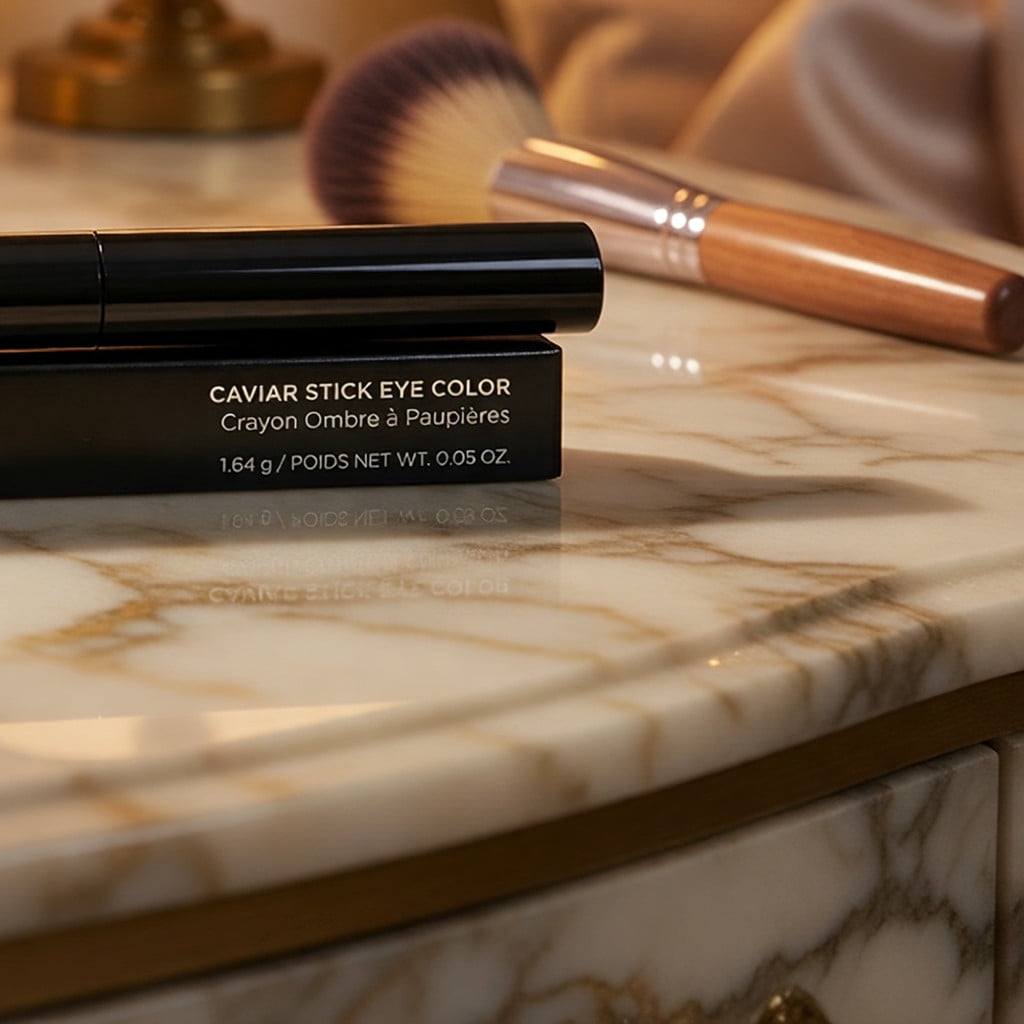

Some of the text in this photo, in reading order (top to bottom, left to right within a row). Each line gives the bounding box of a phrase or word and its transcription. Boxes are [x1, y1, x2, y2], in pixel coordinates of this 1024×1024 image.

[209, 377, 512, 404] CAVIAR STICK EYE COLOR
[220, 406, 511, 435] Crayon Ombre à Paupières
[219, 456, 256, 473] 1.64
[260, 458, 273, 476] g
[290, 452, 350, 471] POIDS
[354, 451, 392, 470] NET
[396, 450, 431, 469] WT.
[435, 449, 477, 468] 0.05
[479, 448, 511, 466] OZ.
